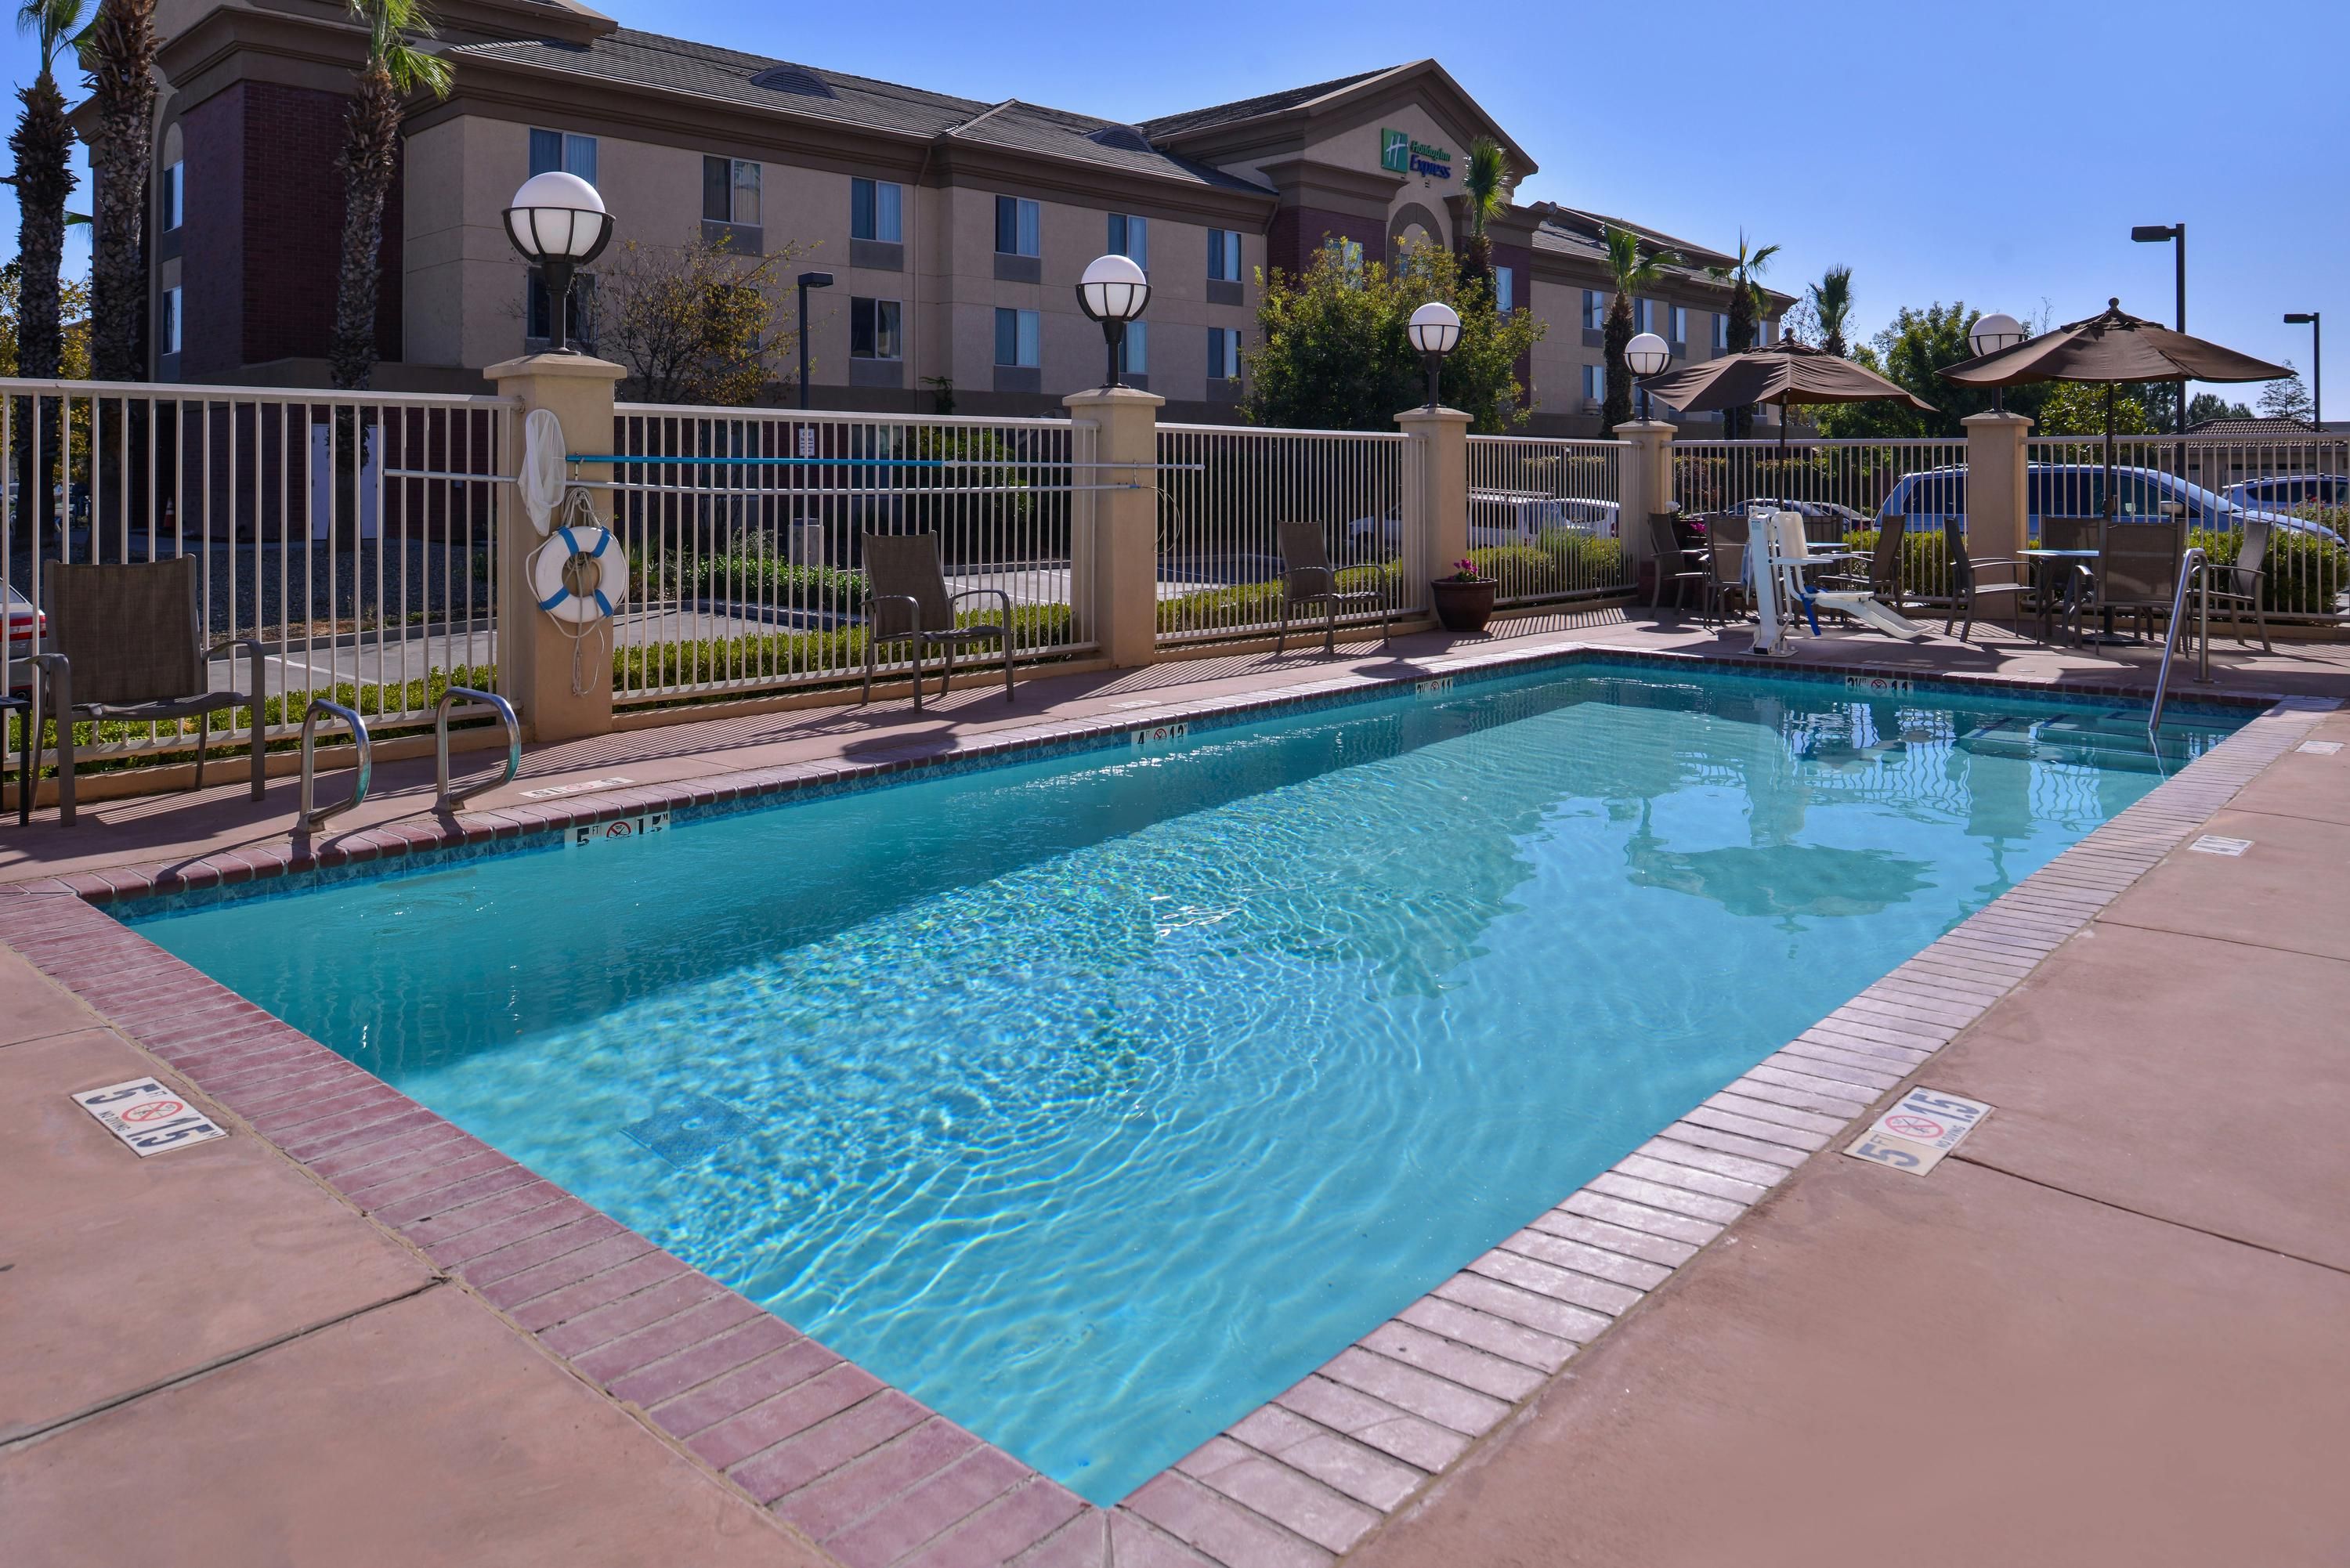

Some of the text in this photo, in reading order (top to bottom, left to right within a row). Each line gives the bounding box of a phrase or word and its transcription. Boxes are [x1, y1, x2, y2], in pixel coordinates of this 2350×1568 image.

[1410, 140, 1439, 161] Holiday
[1410, 154, 1452, 179] Express
[577, 825, 600, 847] 5 FT
[85, 1083, 168, 1104] 5 FT
[1903, 1093, 1980, 1124] 1.5
[106, 1116, 131, 1132] DIVING
[125, 1117, 215, 1147] 1.5
[1943, 1125, 1967, 1143] DIVING
[1856, 1133, 1921, 1167] 5 FT
